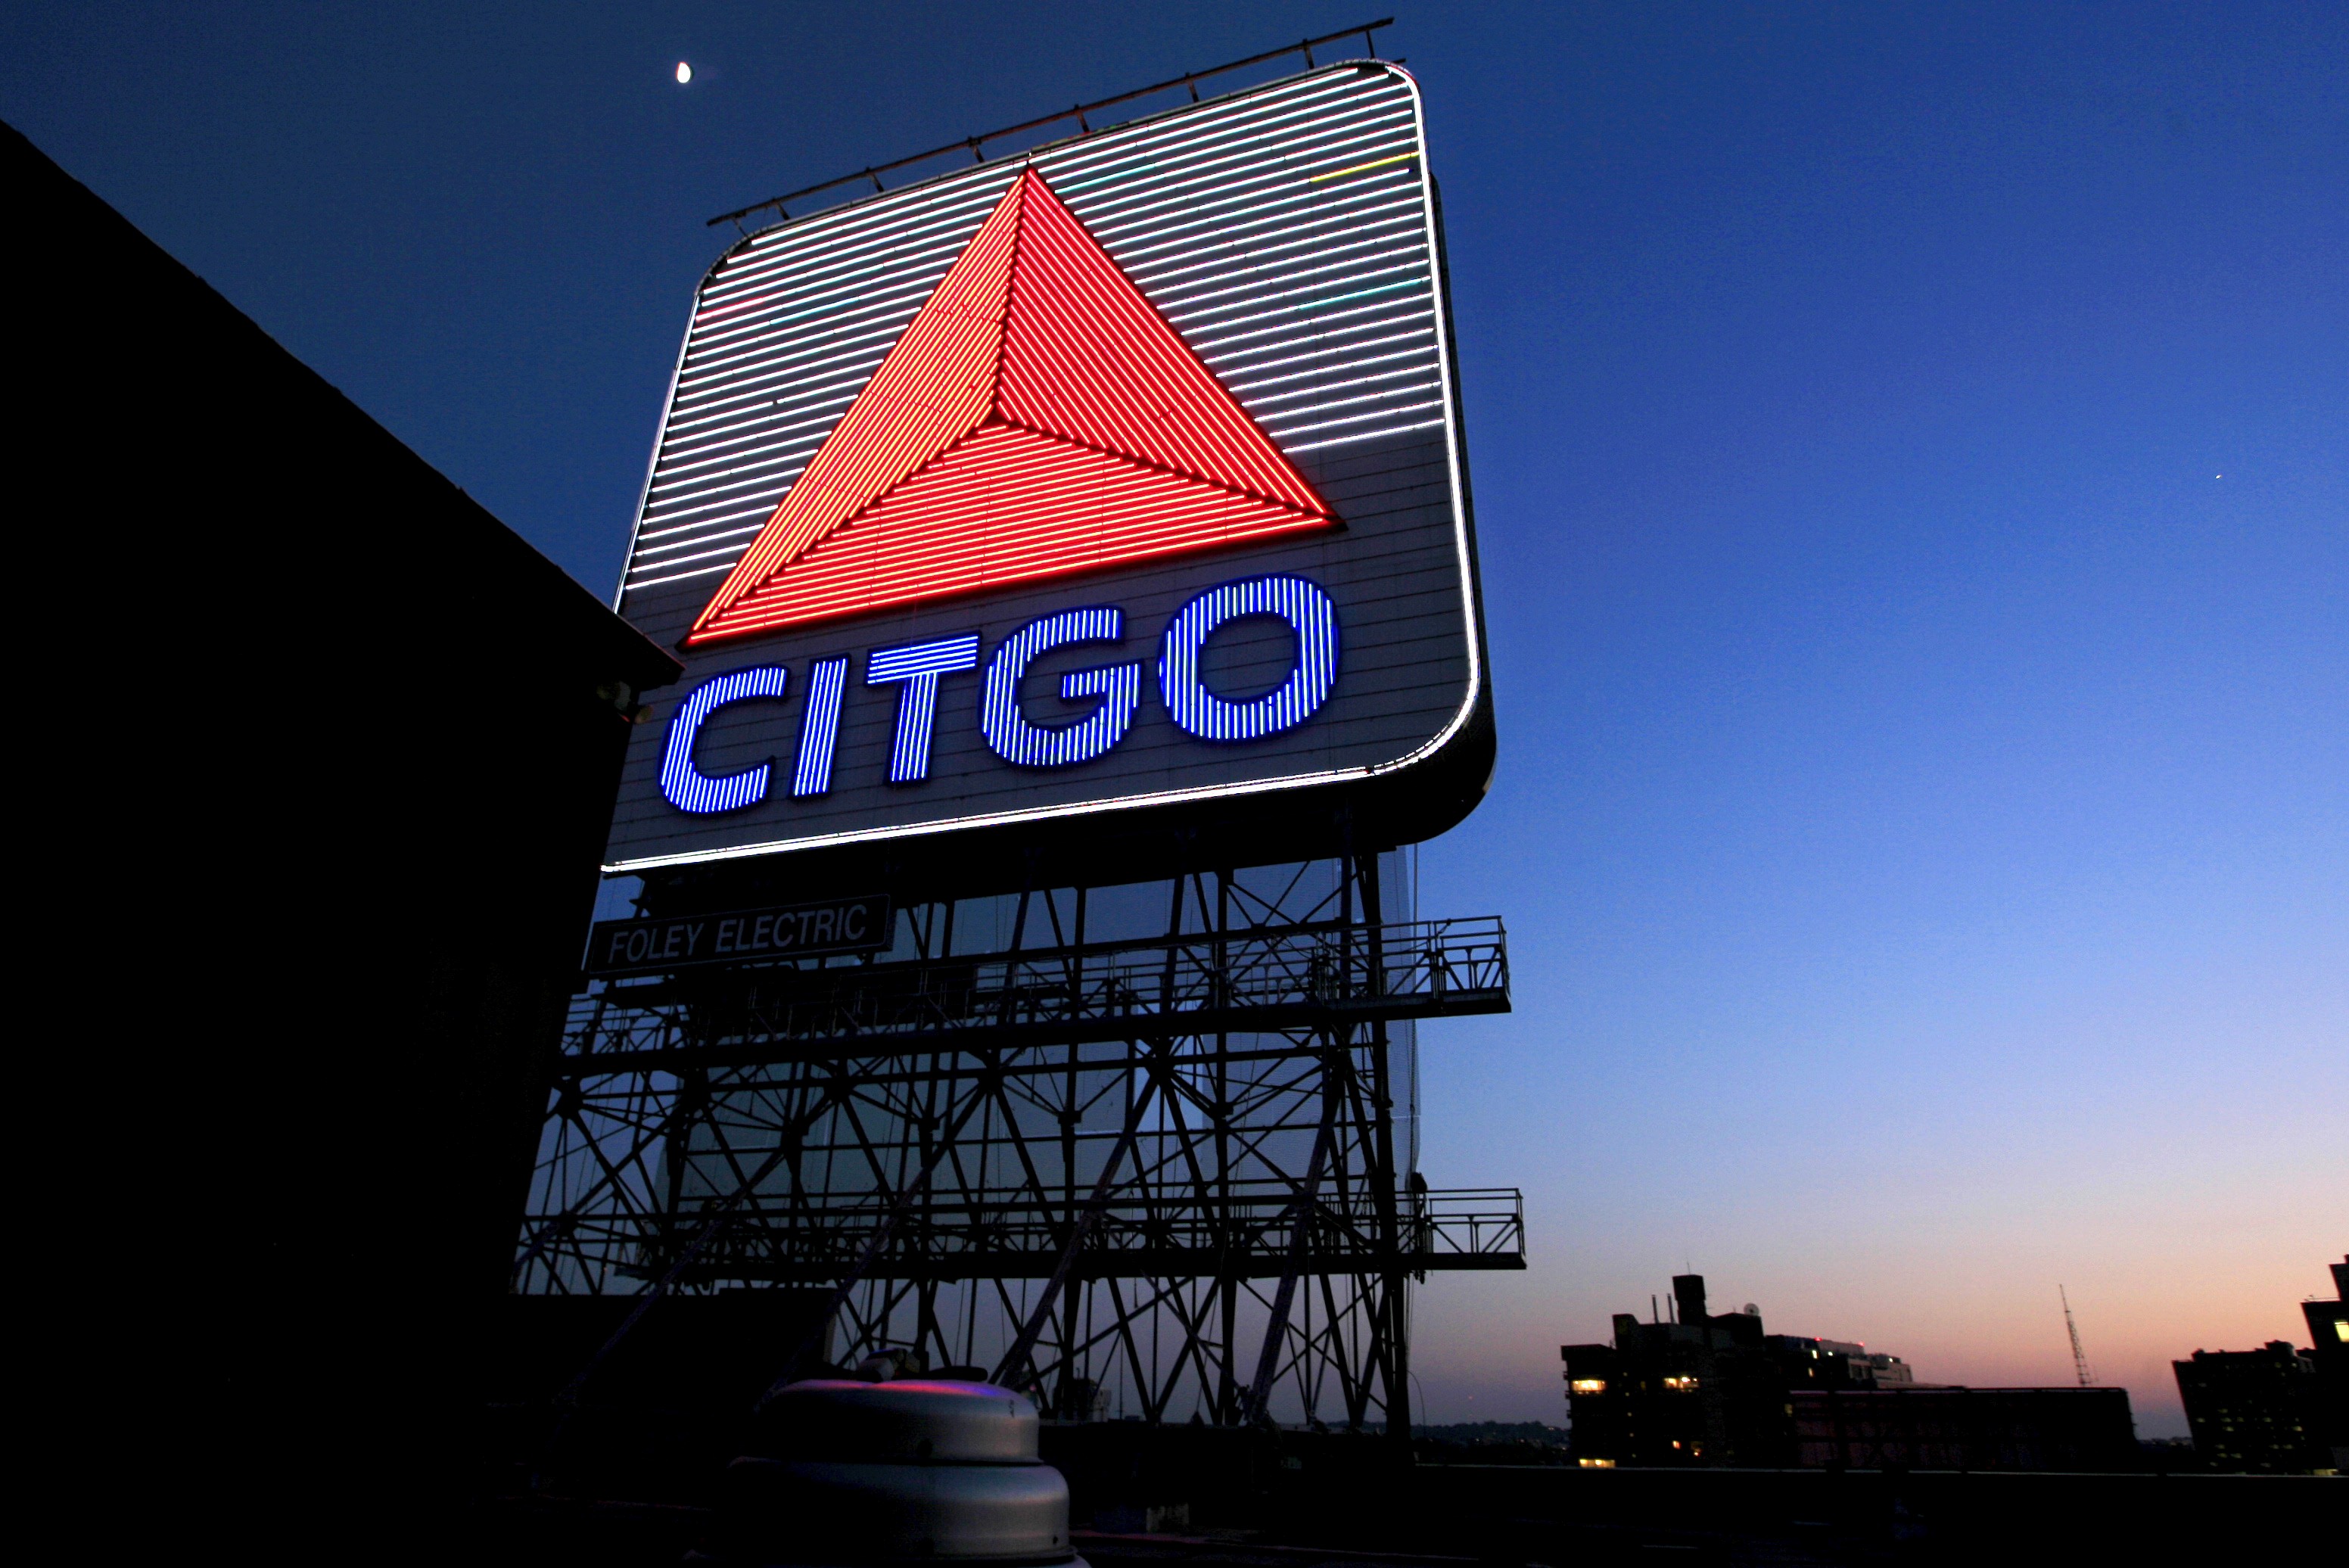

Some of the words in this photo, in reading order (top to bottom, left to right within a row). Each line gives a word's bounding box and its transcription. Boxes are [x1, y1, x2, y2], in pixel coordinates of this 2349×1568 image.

[660, 574, 1341, 816] CITGO
[608, 922, 705, 964] FOLEY
[714, 904, 867, 954] ELECTRIC
